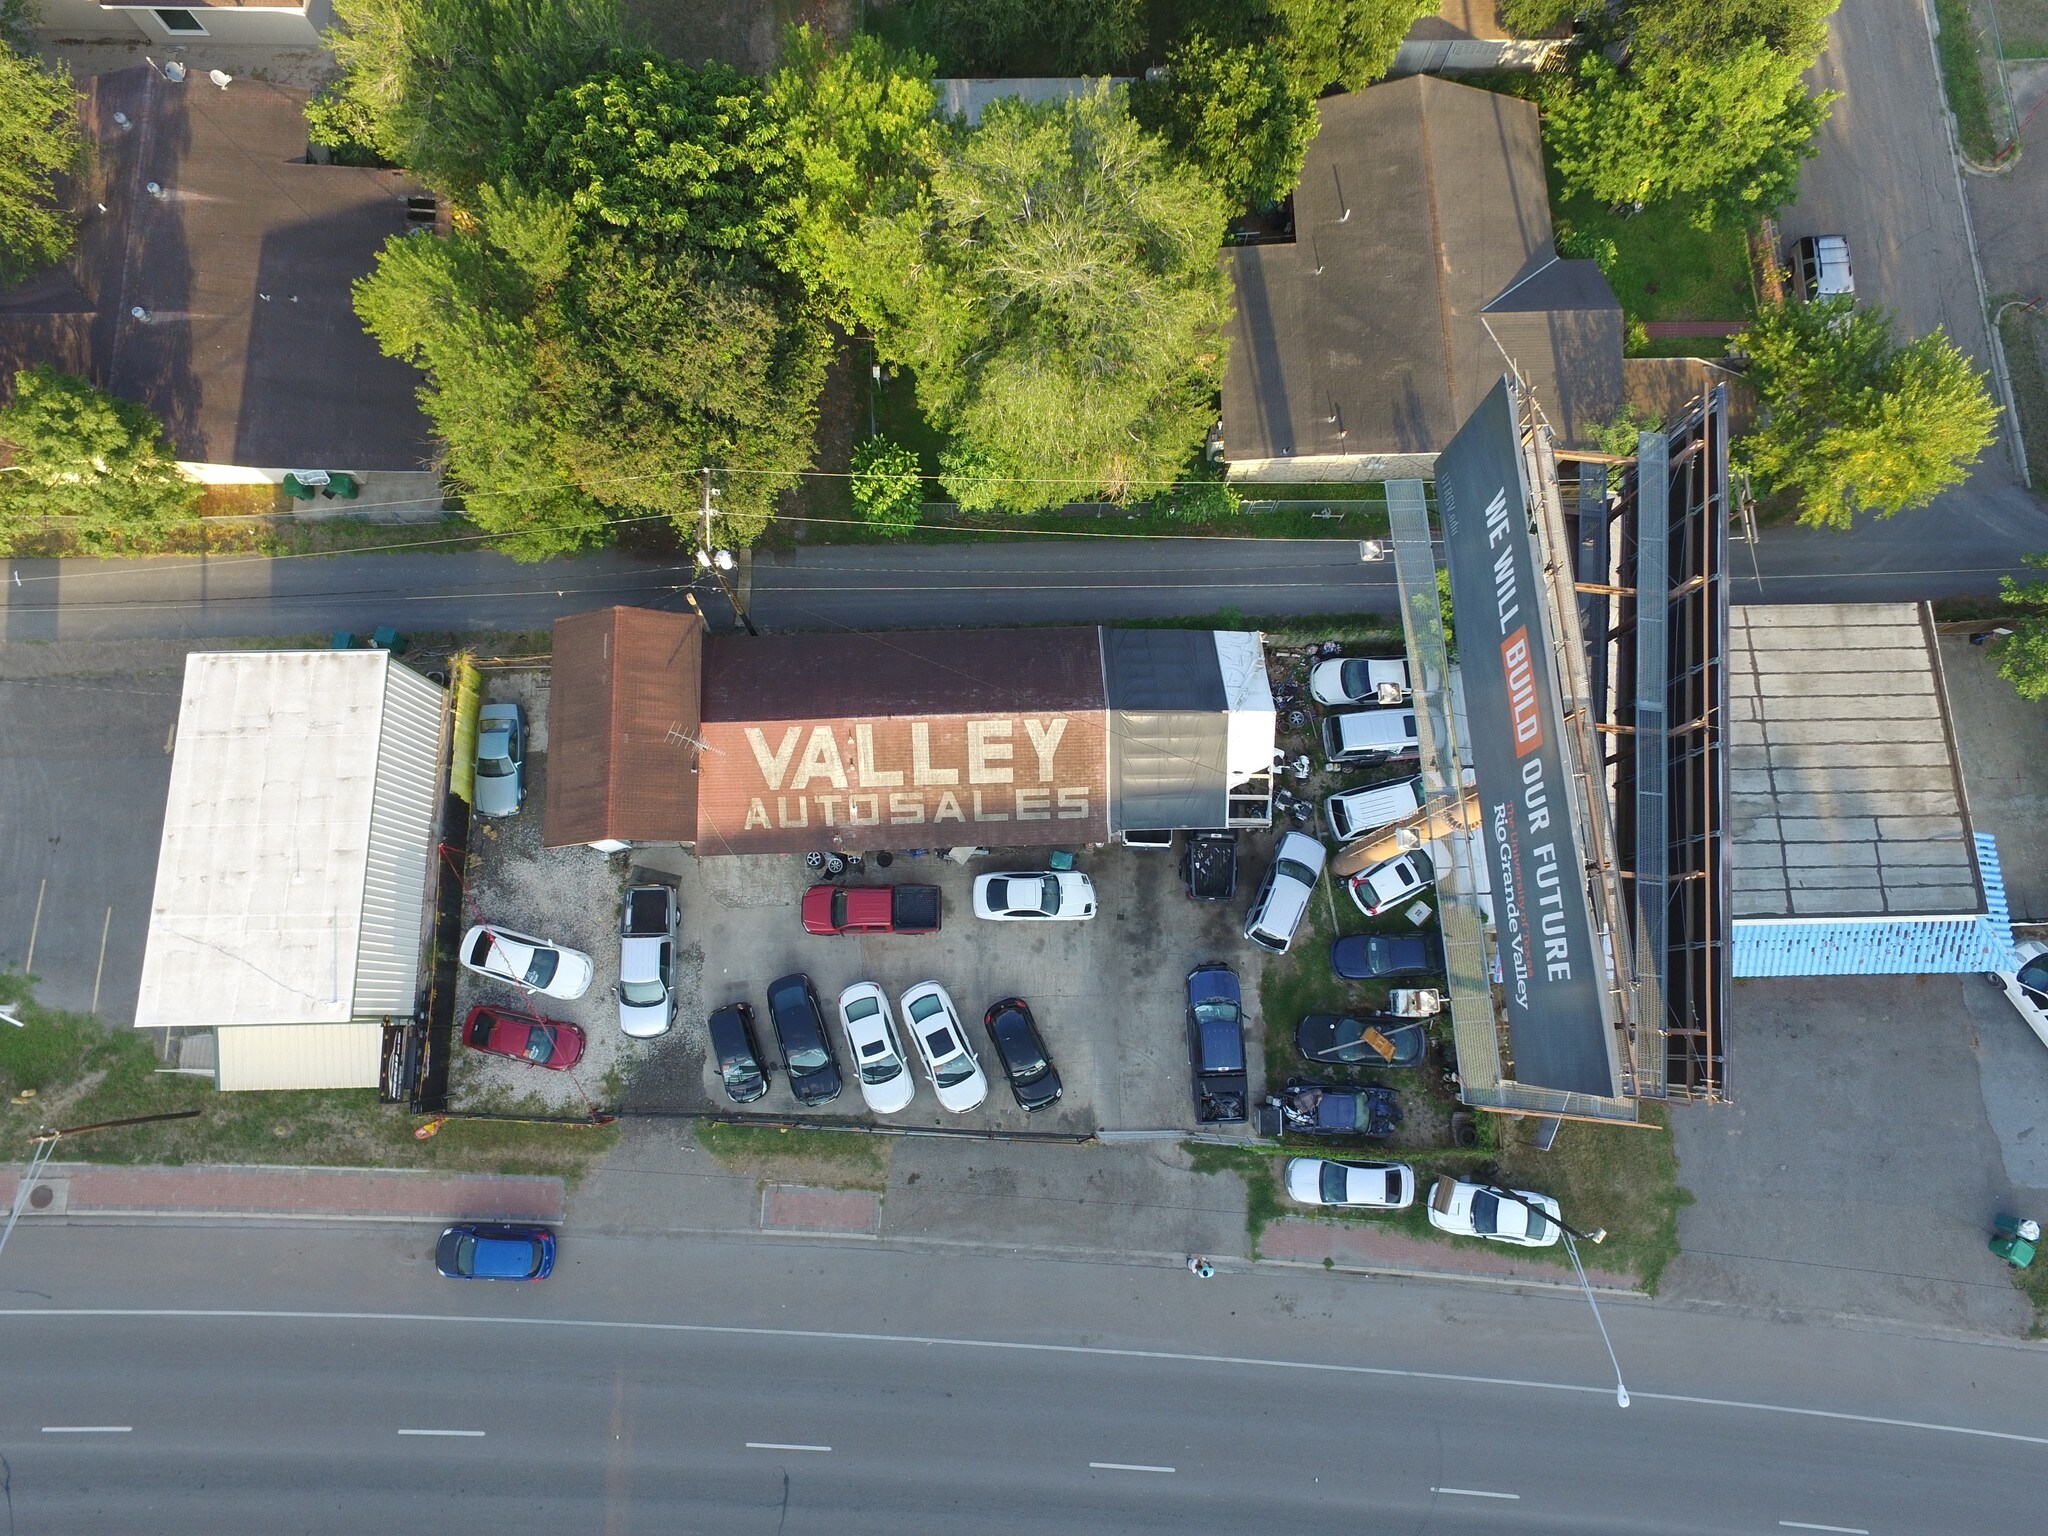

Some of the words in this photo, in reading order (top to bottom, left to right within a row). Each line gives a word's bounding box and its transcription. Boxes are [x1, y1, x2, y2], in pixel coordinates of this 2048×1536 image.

[1441, 472, 1459, 536] UTRGV.edu
[1485, 486, 1510, 550] WE
[1493, 544, 1520, 635] WILL
[1505, 638, 1537, 743] BUILD
[744, 719, 1068, 790] VALLEY
[1493, 803, 1508, 843] Rio
[1522, 757, 1550, 834] OUR
[1500, 843, 1520, 933] Grande
[1507, 800, 1515, 828] The
[1511, 831, 1525, 910] University
[1523, 929, 1533, 978] Texas
[1533, 842, 1572, 982] FUTURE
[1511, 933, 1528, 1010] Valley
